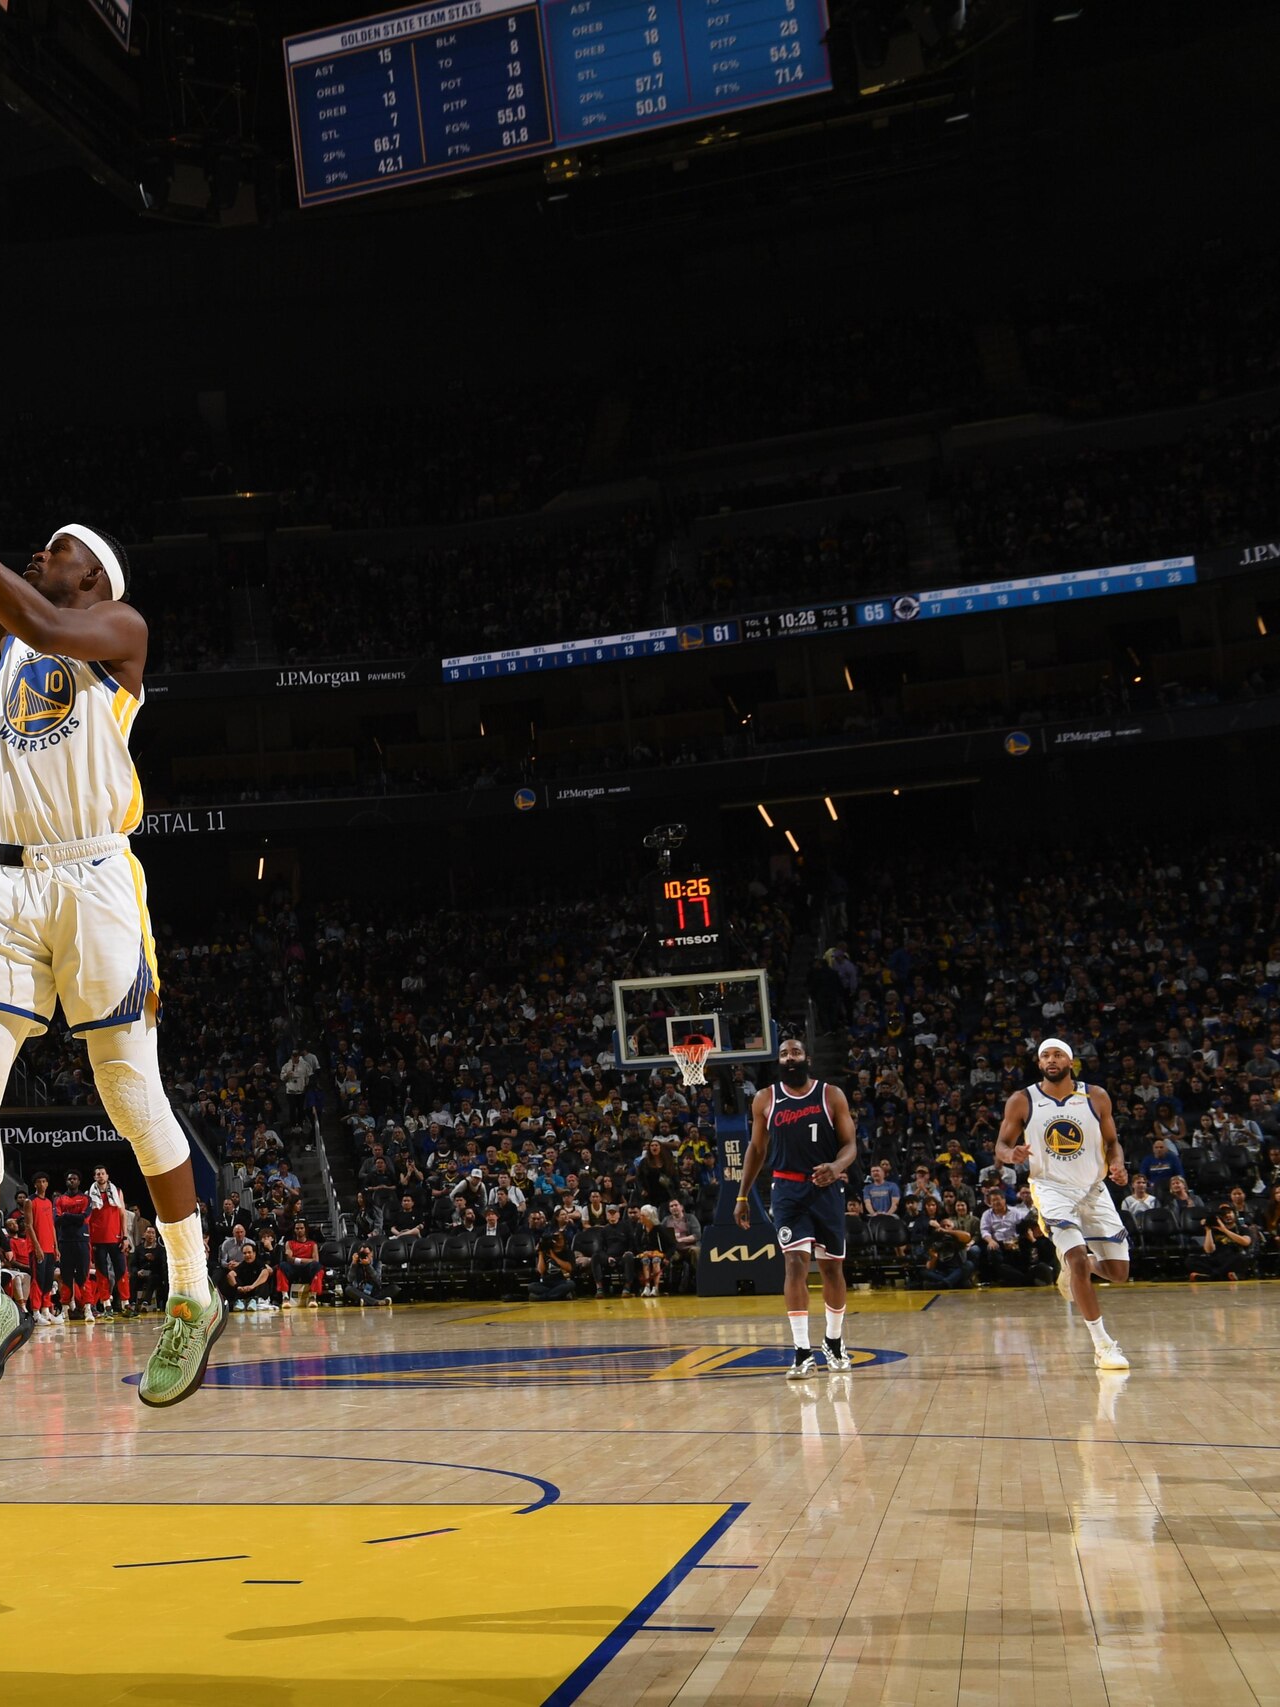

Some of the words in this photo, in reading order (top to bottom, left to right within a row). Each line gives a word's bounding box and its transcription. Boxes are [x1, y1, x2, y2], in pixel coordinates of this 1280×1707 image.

[570, 2, 591, 16] AST
[341, 24, 380, 47] GOLDEN
[383, 17, 415, 37] STATE
[419, 11, 446, 29] TEAM
[448, 3, 482, 21] STATS
[572, 22, 603, 37] OREB
[648, 6, 657, 22] 2
[435, 34, 456, 49] BLK
[508, 17, 517, 33] 5
[438, 58, 453, 70] TO
[510, 39, 519, 54] 8
[574, 44, 605, 60] DREB
[643, 28, 659, 46] 18
[769, 41, 801, 62] 54.3
[314, 65, 335, 79] AST
[378, 48, 392, 64] 15
[577, 69, 598, 82] STL
[652, 51, 662, 67] 6
[775, 64, 804, 84] 71.4
[317, 84, 345, 98] OREB
[387, 70, 395, 84] 1
[440, 78, 462, 92] POT
[507, 61, 521, 78] 13
[635, 72, 664, 93] 57.7
[319, 105, 347, 120] DREB
[383, 91, 397, 107] 13
[443, 99, 468, 113] PITP
[636, 95, 667, 116] 50.0
[321, 129, 340, 142] STL
[390, 112, 398, 127] 7
[445, 121, 470, 135] FG%
[497, 105, 526, 125] 55.0
[447, 144, 470, 157] FT%
[502, 127, 528, 146] 81.8
[323, 150, 346, 164] 2P%
[325, 171, 348, 184] 3P%
[377, 156, 404, 174] 42.1
[778, 610, 816, 628] 10:26
[864, 603, 885, 622] 65
[712, 624, 730, 642] 61
[450, 668, 459, 680] 15
[480, 665, 486, 676] 1
[506, 661, 516, 673] 13
[537, 657, 544, 668] 7
[624, 645, 635, 656] 13
[44, 670, 64, 693] 10
[276, 669, 360, 688] J.P.Morgan
[367, 672, 406, 681] PAYMENTS
[206, 810, 227, 831] 11
[664, 878, 711, 899] 10:26
[677, 896, 711, 930] 17
[676, 934, 720, 946] TISSOT
[774, 1104, 823, 1127] Clippers
[808, 1123, 819, 1142] 1
[1068, 1128, 1076, 1138] 4
[724, 1140, 740, 1153] GET
[1044, 1147, 1086, 1161] WARRIORS
[726, 1153, 742, 1167] THE
[709, 1243, 776, 1263] KIA
